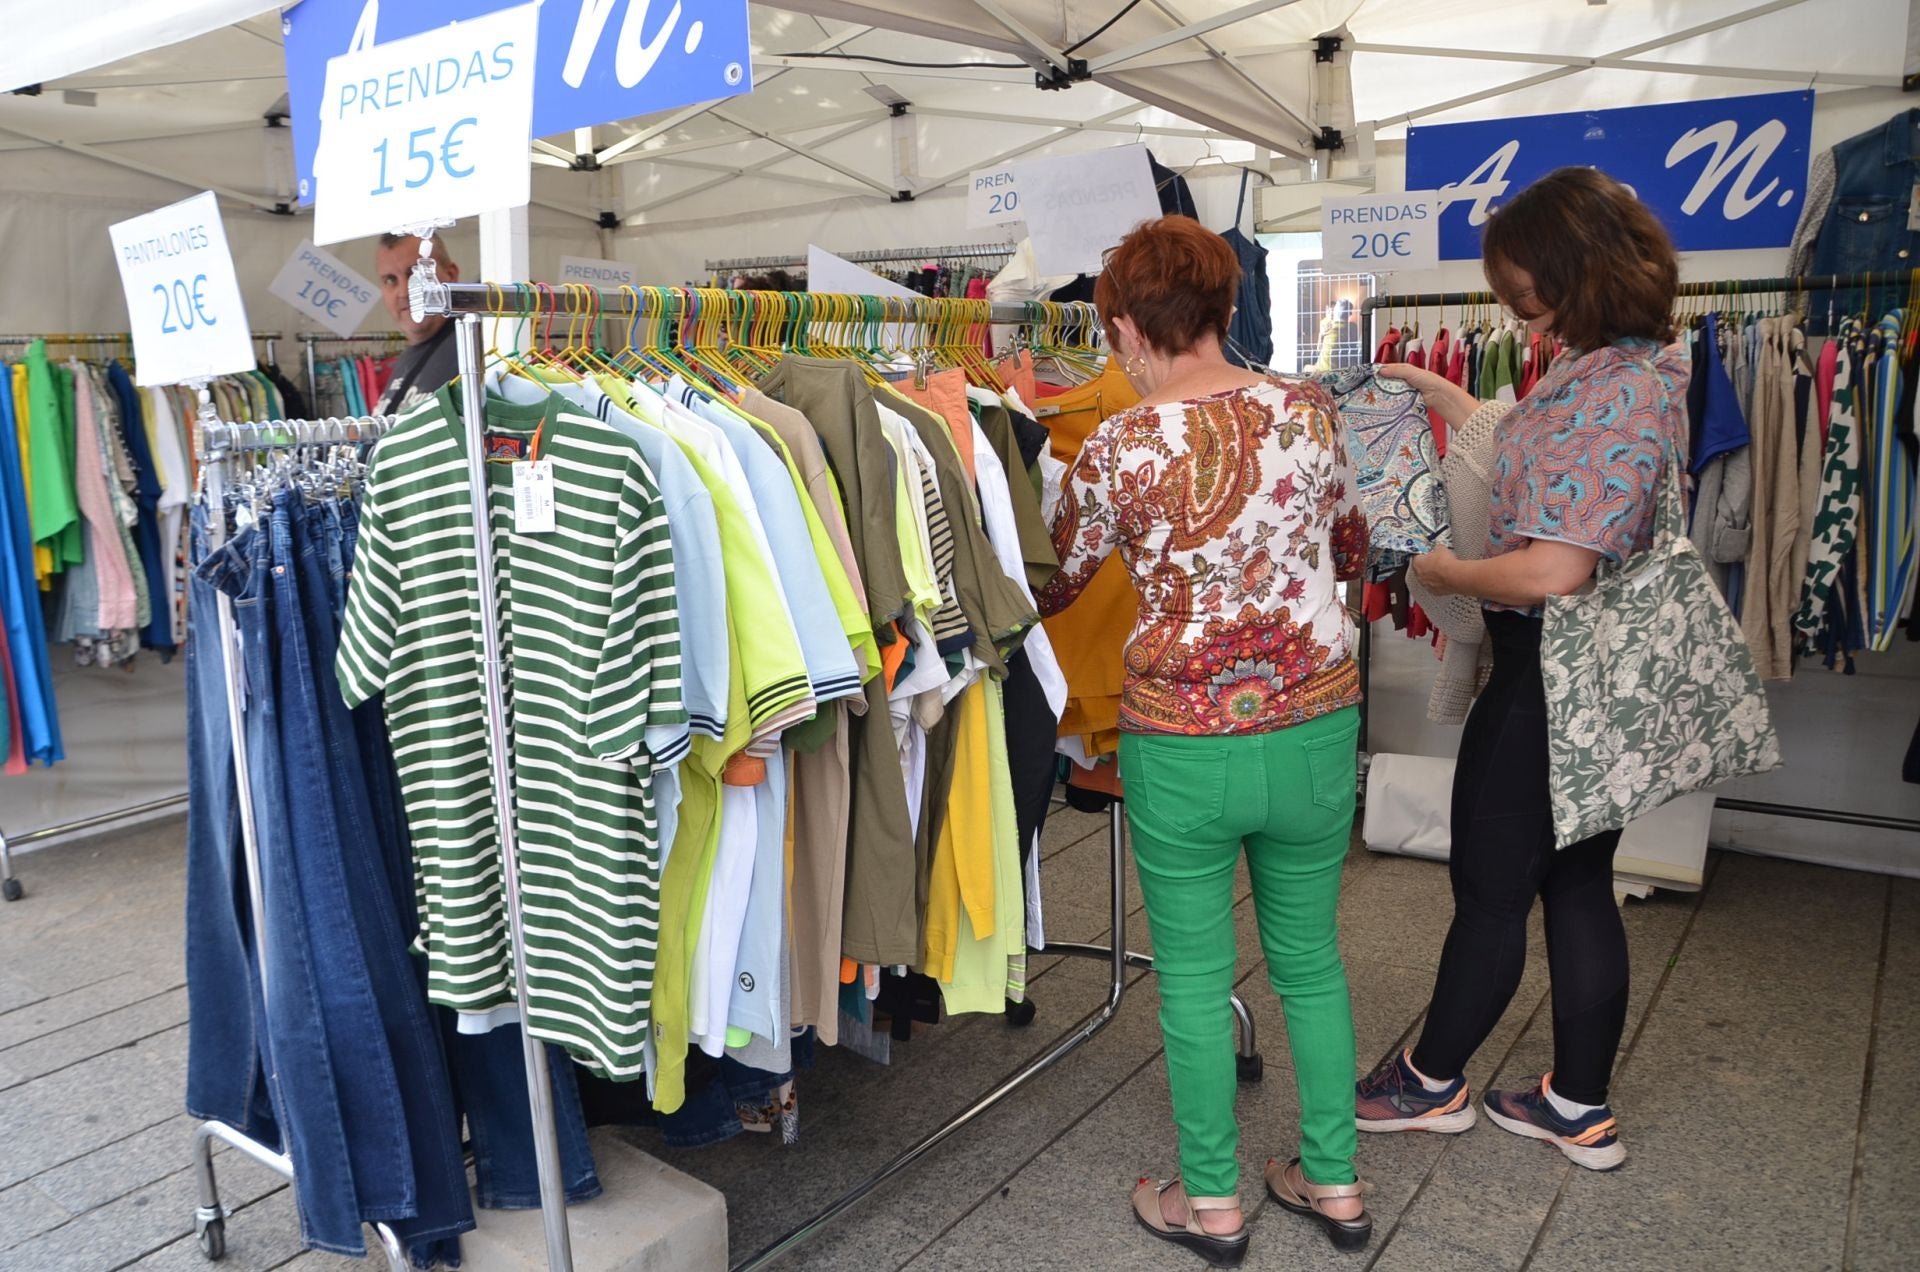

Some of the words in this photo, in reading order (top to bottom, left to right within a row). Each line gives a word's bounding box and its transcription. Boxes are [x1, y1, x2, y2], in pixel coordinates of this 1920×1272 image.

[339, 42, 514, 120] PRENDAS
[370, 117, 478, 197] 15€
[975, 172, 1015, 190] PREN
[989, 191, 1018, 214] 20
[1331, 203, 1427, 224] PRENDAS
[124, 225, 209, 266] PANTALONES
[1351, 232, 1411, 259] 20€
[299, 250, 372, 304] PRENDAS
[565, 264, 631, 283] PRENDAS
[153, 274, 217, 334] 20€
[296, 280, 347, 318] 10€
